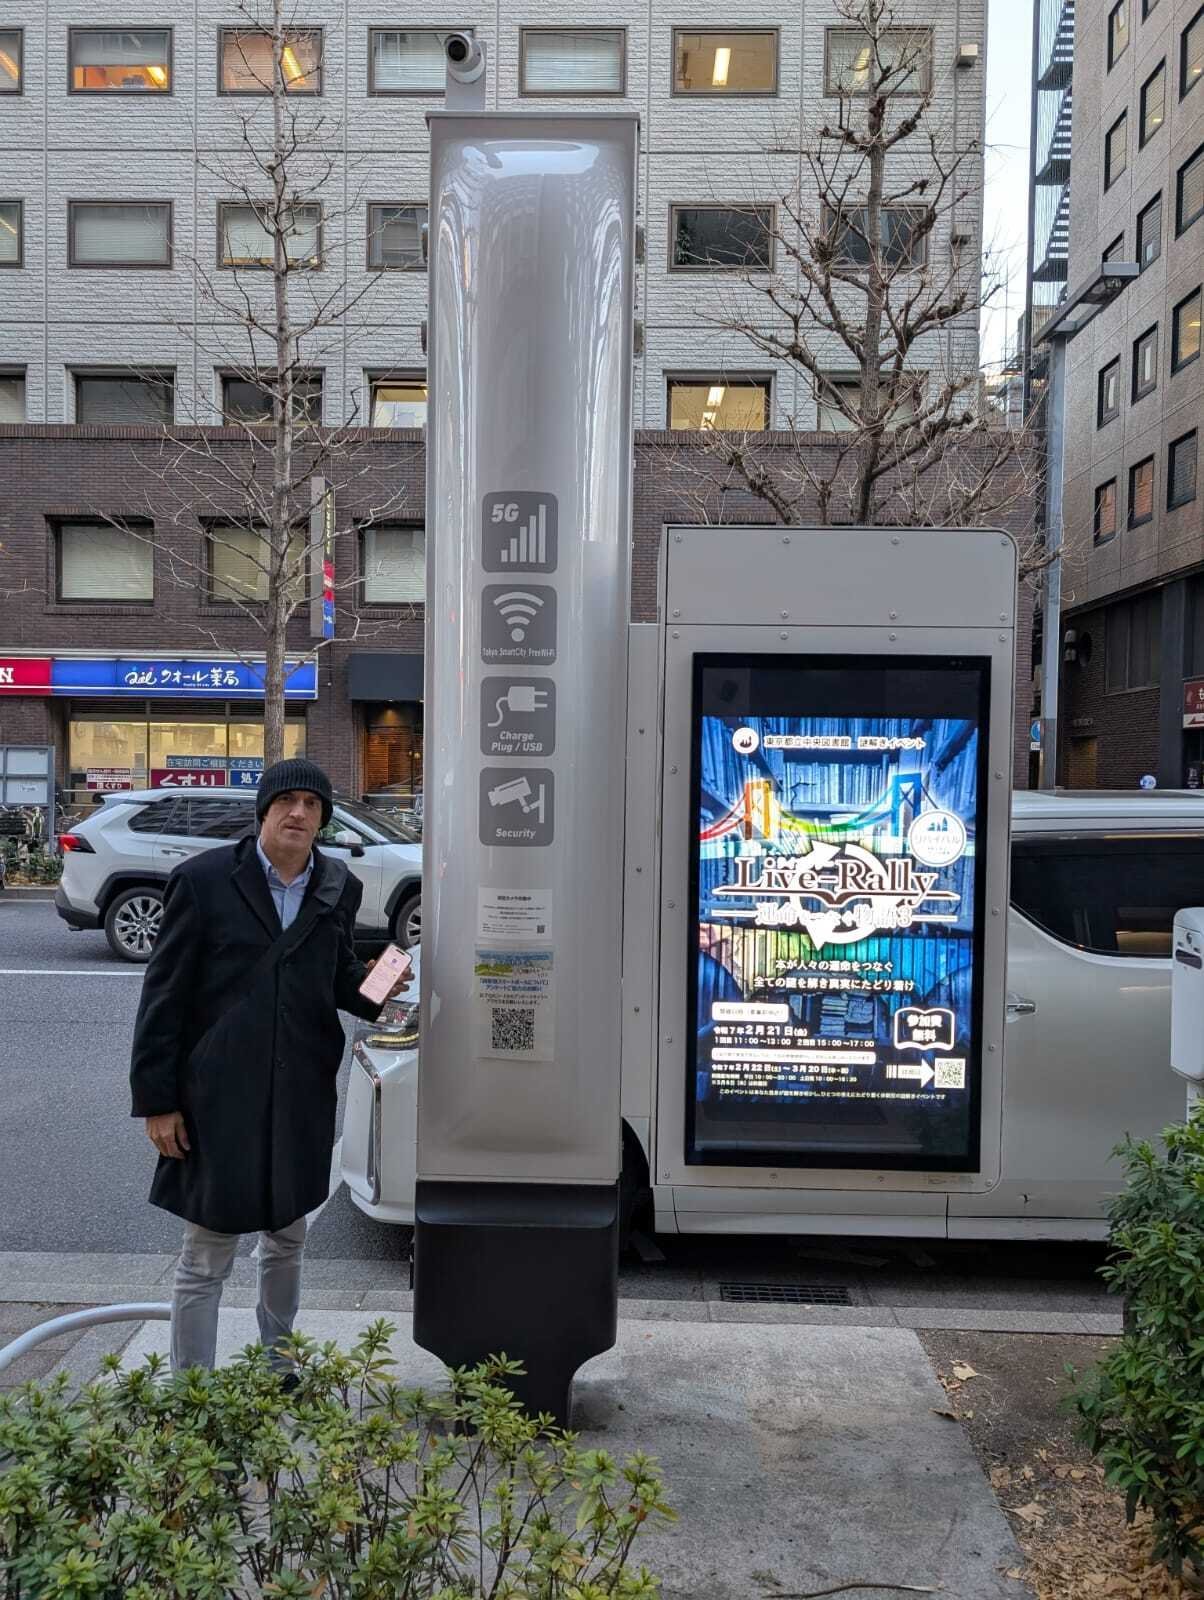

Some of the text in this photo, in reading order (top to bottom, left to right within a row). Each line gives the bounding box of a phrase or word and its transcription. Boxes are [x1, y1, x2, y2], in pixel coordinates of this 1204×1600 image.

[491, 503, 519, 523] 5G
[161, 667, 239, 686] クオール薬局
[500, 731, 534, 742] Charge
[491, 742, 512, 752] Plug
[523, 742, 543, 752] USB
[496, 828, 536, 839] Security
[736, 858, 938, 906] Live-Rally
[775, 959, 893, 972] 本が人々の運命をつなぐ
